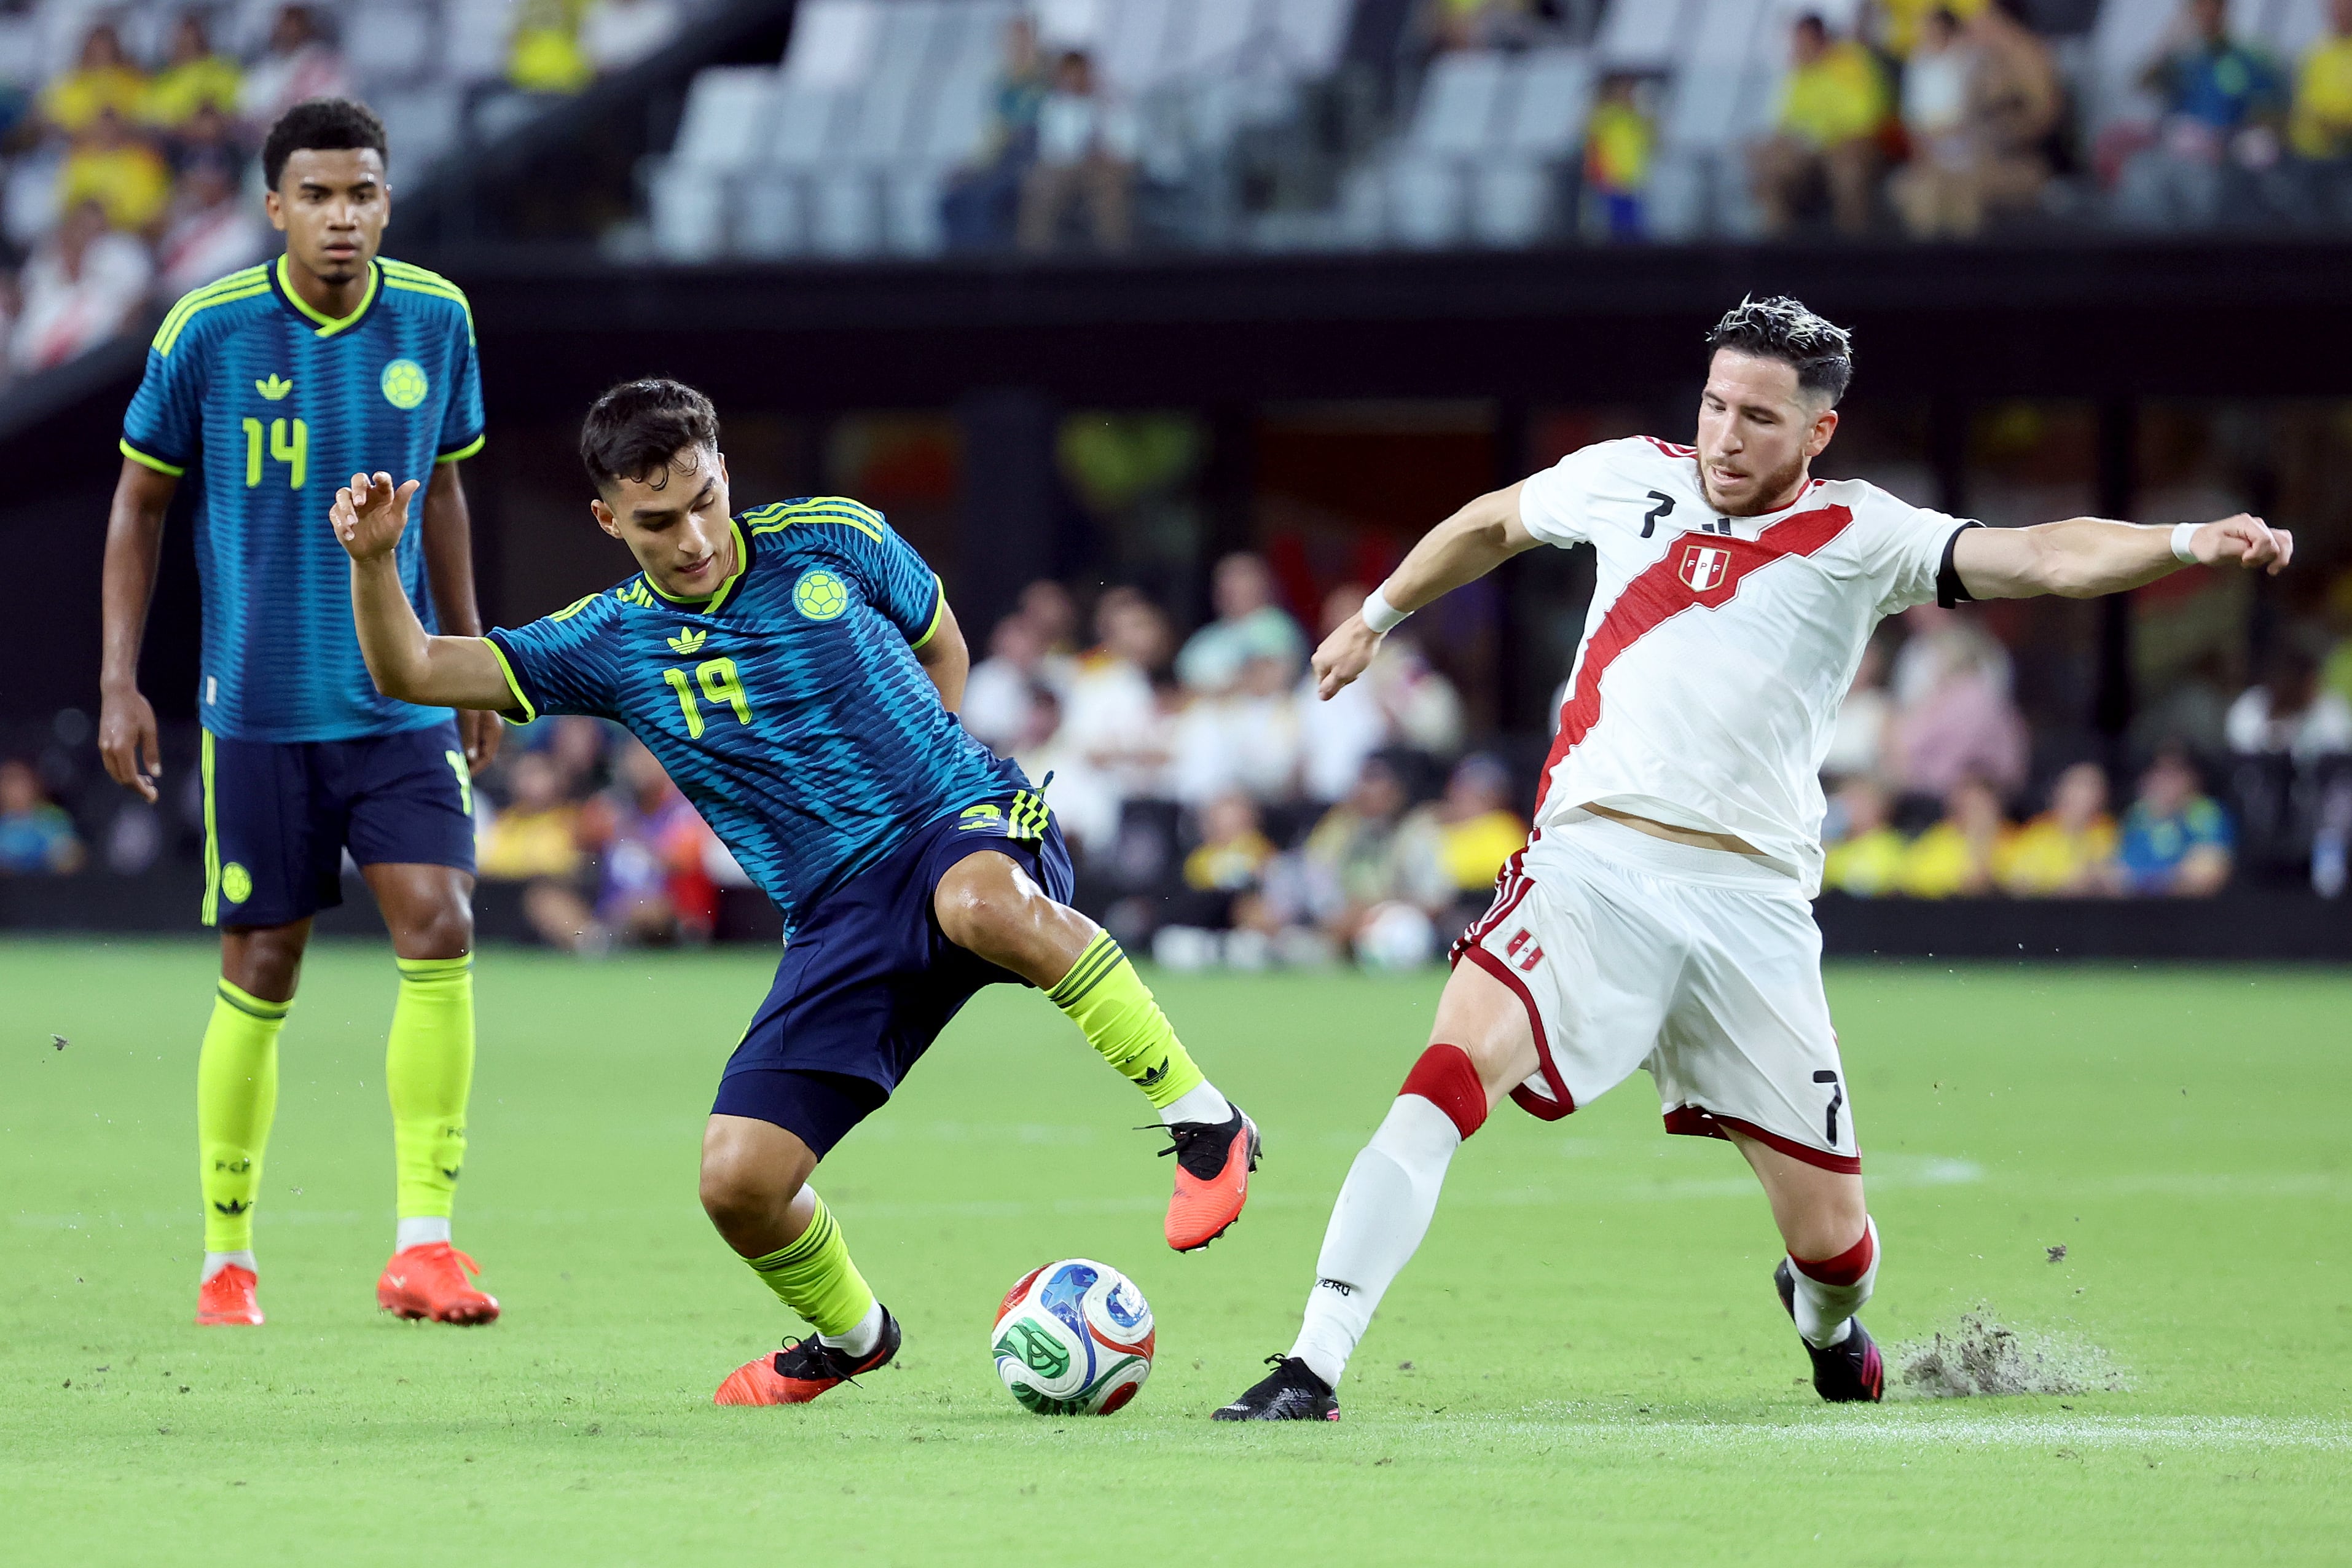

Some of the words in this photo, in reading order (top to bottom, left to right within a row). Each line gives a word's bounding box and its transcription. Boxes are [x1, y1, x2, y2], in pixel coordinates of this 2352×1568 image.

[242, 417, 308, 490] 14
[1641, 490, 1676, 538] 7
[663, 657, 753, 739] 19
[1813, 1070, 1842, 1147] 7
